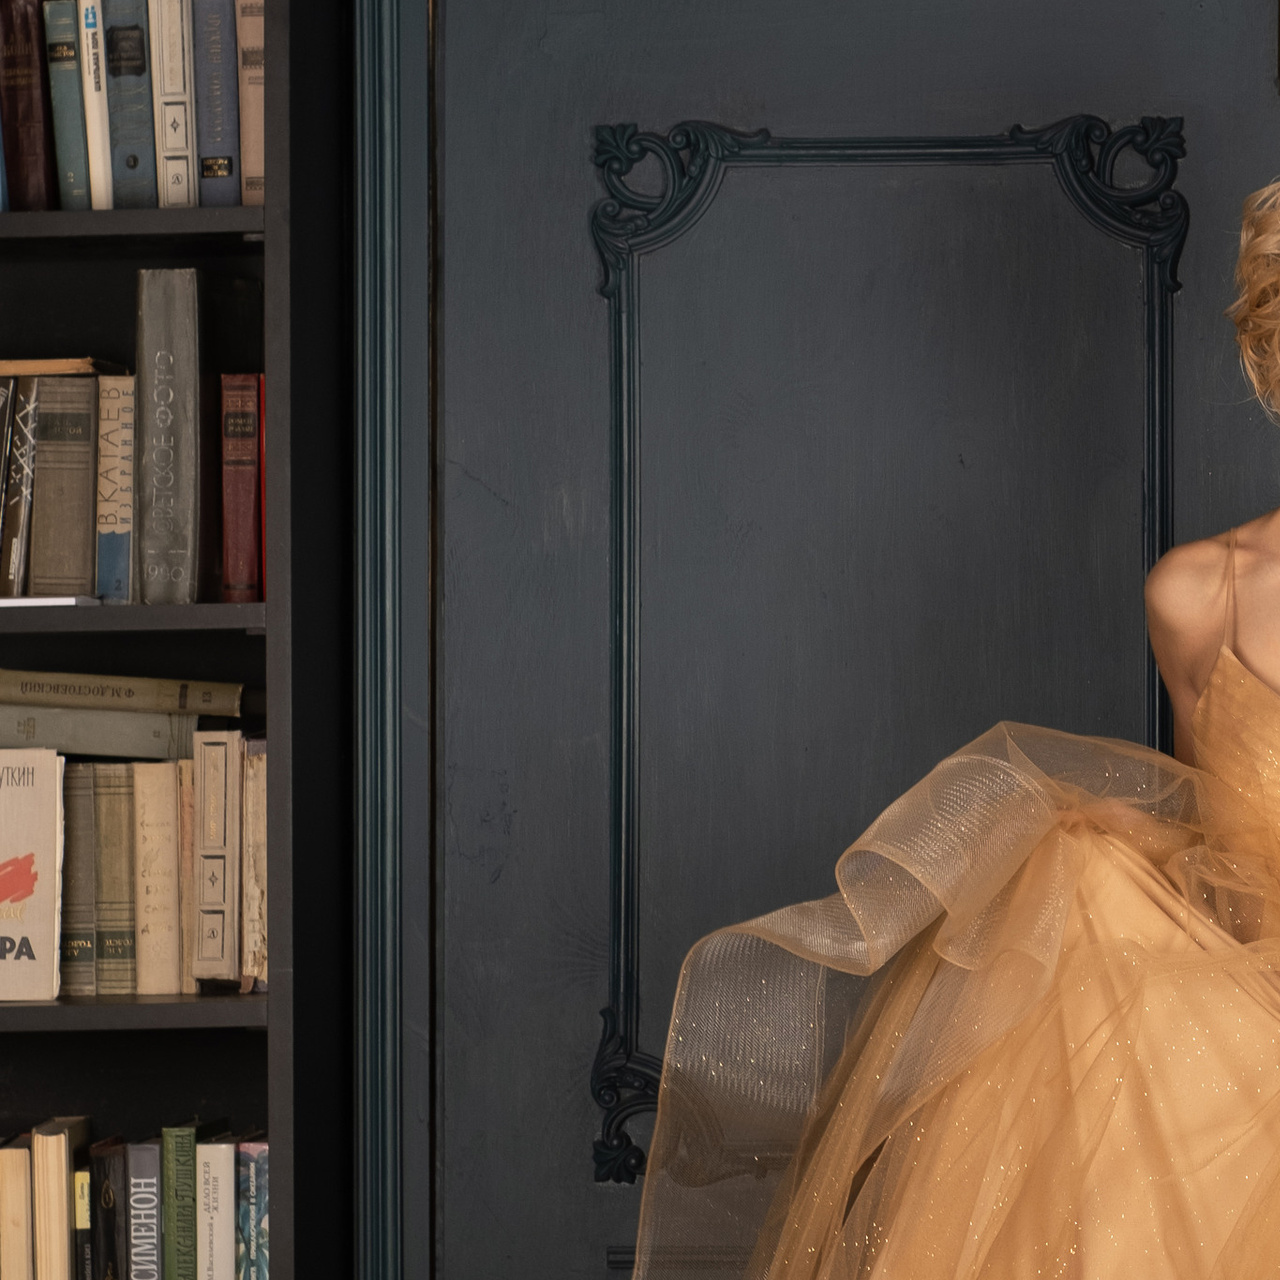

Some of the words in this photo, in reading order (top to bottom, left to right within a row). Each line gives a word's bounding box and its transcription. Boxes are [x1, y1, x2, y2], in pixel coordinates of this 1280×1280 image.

[120, 388, 134, 525] ИЗБРАННОЕ
[114, 579, 122, 592] 2
[202, 1161, 211, 1188] ВСЕЙ
[203, 1189, 211, 1214] ДЕЛО
[211, 1176, 220, 1214] ЖИЗНИ
